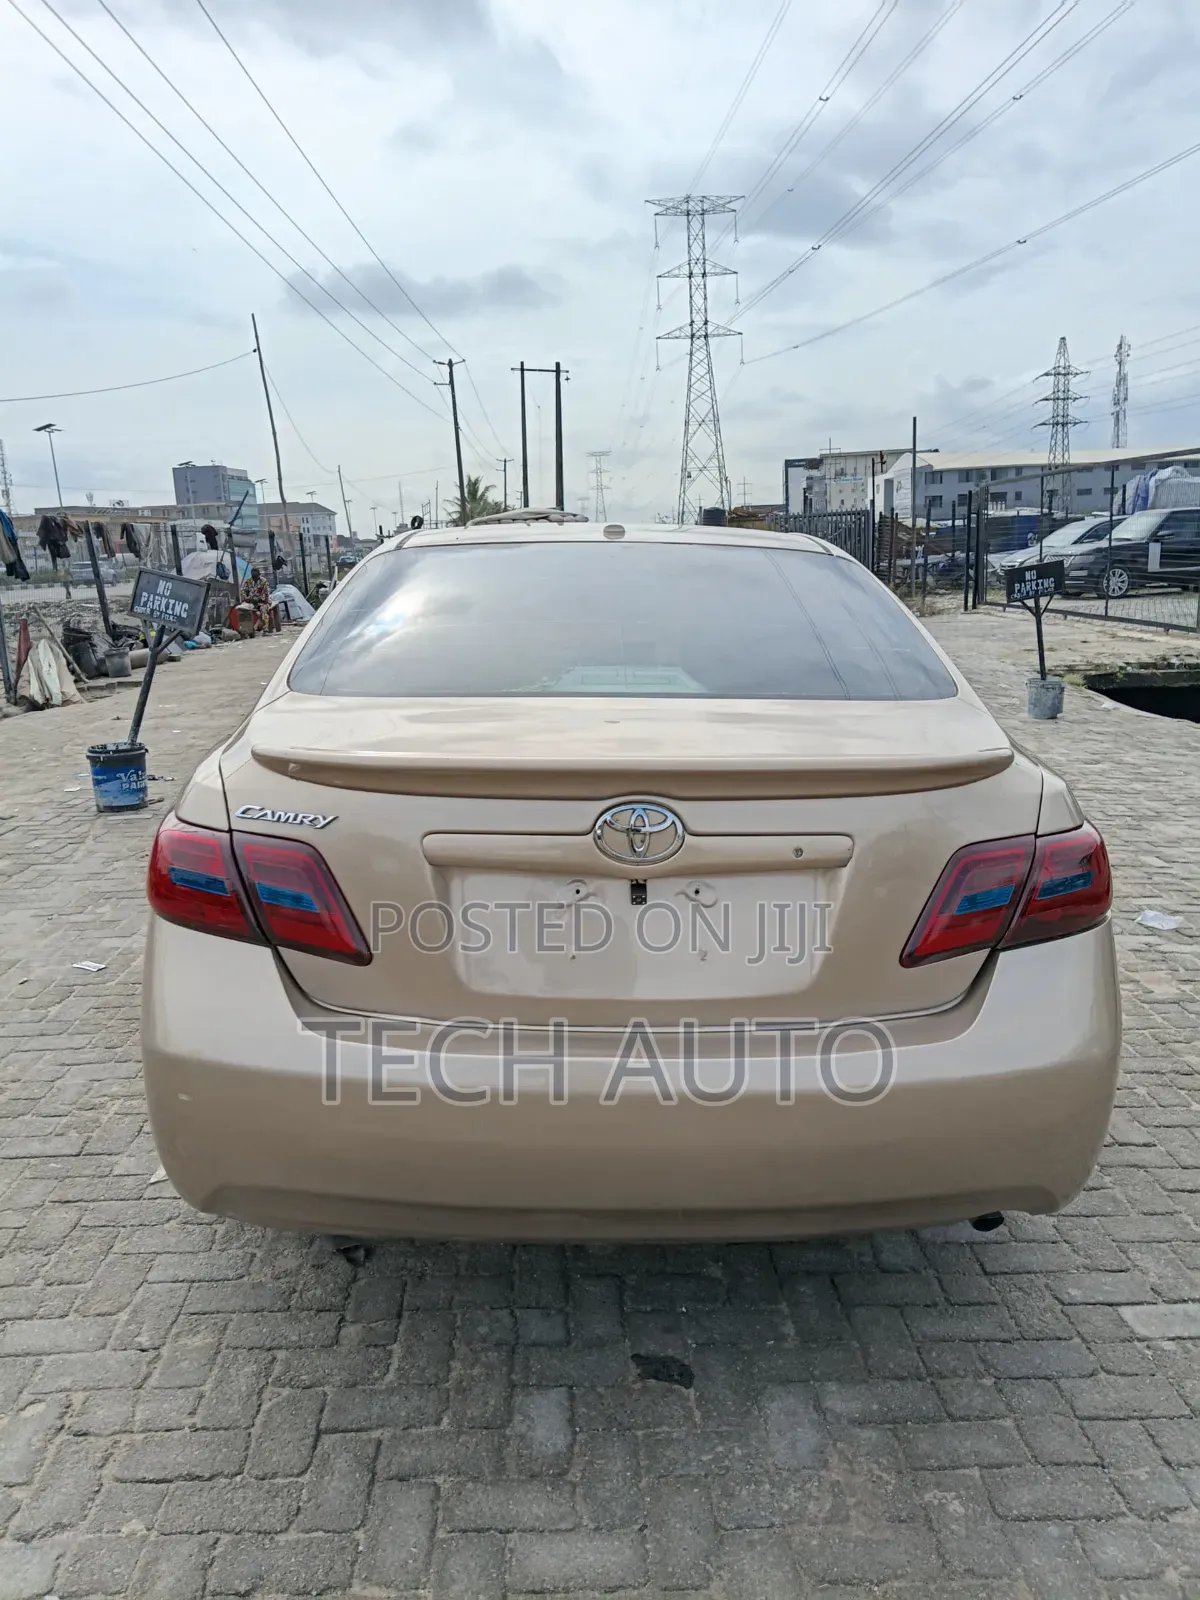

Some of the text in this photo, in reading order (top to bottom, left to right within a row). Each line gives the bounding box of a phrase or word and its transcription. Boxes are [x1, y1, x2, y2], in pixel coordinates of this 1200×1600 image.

[1025, 570, 1037, 581] NO
[156, 579, 173, 596] NO
[1014, 577, 1055, 595] PARKING
[140, 591, 189, 618] PARKING
[234, 804, 339, 829] CAMRY
